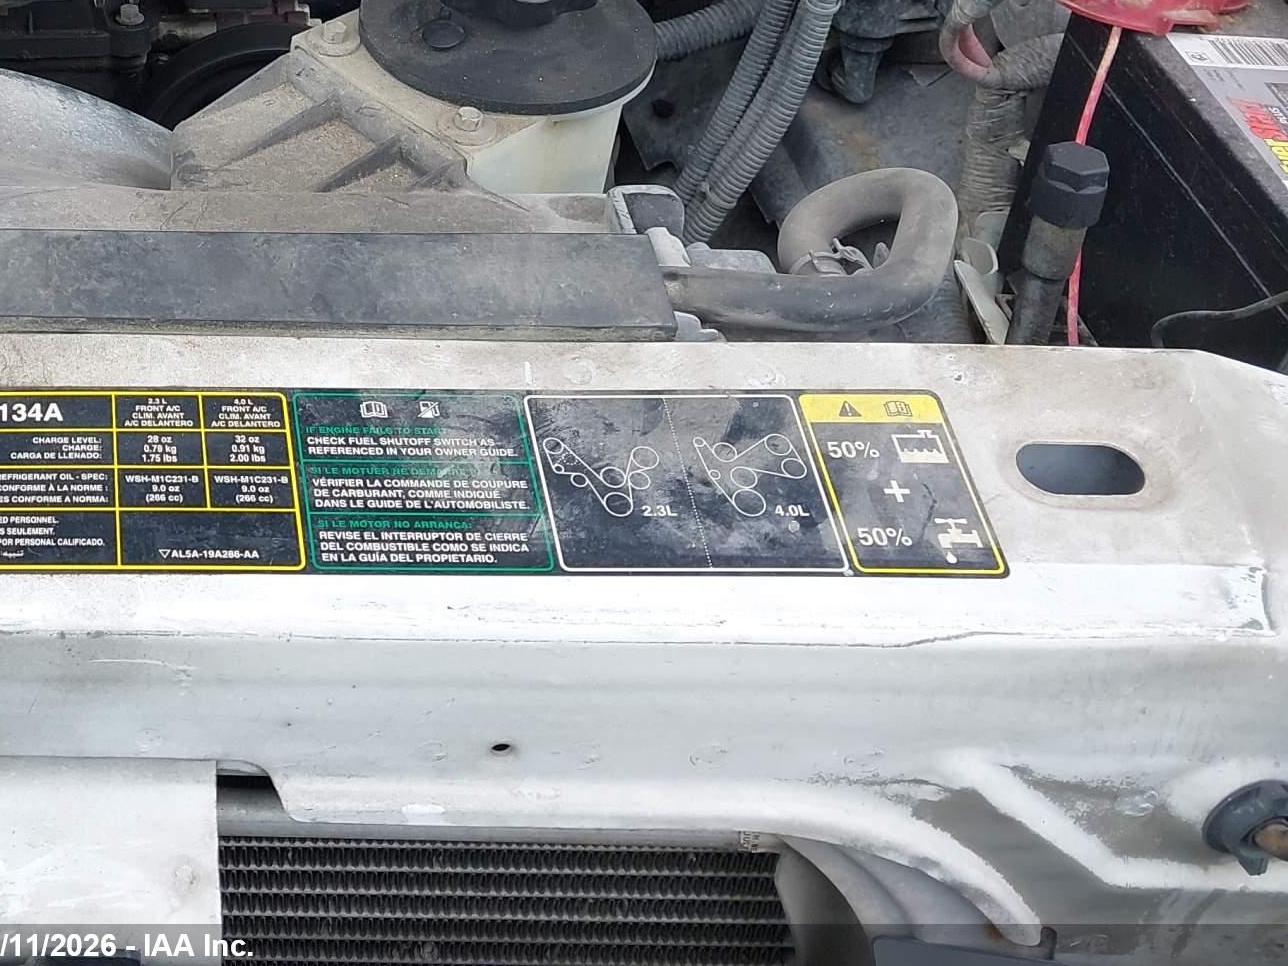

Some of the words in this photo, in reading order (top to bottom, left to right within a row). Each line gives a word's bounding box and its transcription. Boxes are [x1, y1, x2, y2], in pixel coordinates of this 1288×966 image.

[348, 437, 377, 445] FUEL
[433, 438, 476, 446] SWITCH
[253, 445, 265, 454] kg
[308, 447, 383, 455] REFERENCED
[432, 448, 477, 456] OWNER
[480, 449, 518, 457] GUIDE.
[828, 442, 880, 458] 50%
[313, 477, 362, 487] VÉRIFIER
[366, 479, 380, 487] LA
[384, 479, 450, 488] COMMANDE
[453, 480, 469, 488] DE
[472, 480, 527, 489] COUPURE
[331, 489, 405, 498] CARBURANT,
[408, 490, 451, 498] COMME
[454, 488, 501, 498] INDIQUÉ
[315, 499, 347, 507] DANS
[367, 500, 402, 508] GUIDE
[406, 500, 421, 508] DE
[424, 500, 530, 509] L'AUTOMOBILISTE.
[642, 506, 677, 517] 2.3L
[774, 504, 810, 516] 4.0L
[319, 531, 360, 539] REVISE
[364, 532, 378, 540] EL
[381, 532, 463, 541] INTERRUPTOR
[466, 533, 481, 541] DE
[484, 533, 528, 541] CIERRE
[857, 528, 912, 546] 50%
[346, 543, 430, 551] COMBUSTIBLE
[433, 543, 468, 552] COMO
[471, 544, 486, 552] SE
[489, 544, 529, 552] INDICA
[322, 553, 338, 562] EN
[341, 554, 356, 562] LA
[359, 551, 386, 562] GUÍA
[390, 554, 413, 562] DEL
[416, 554, 498, 563] PROPIETARIO.
